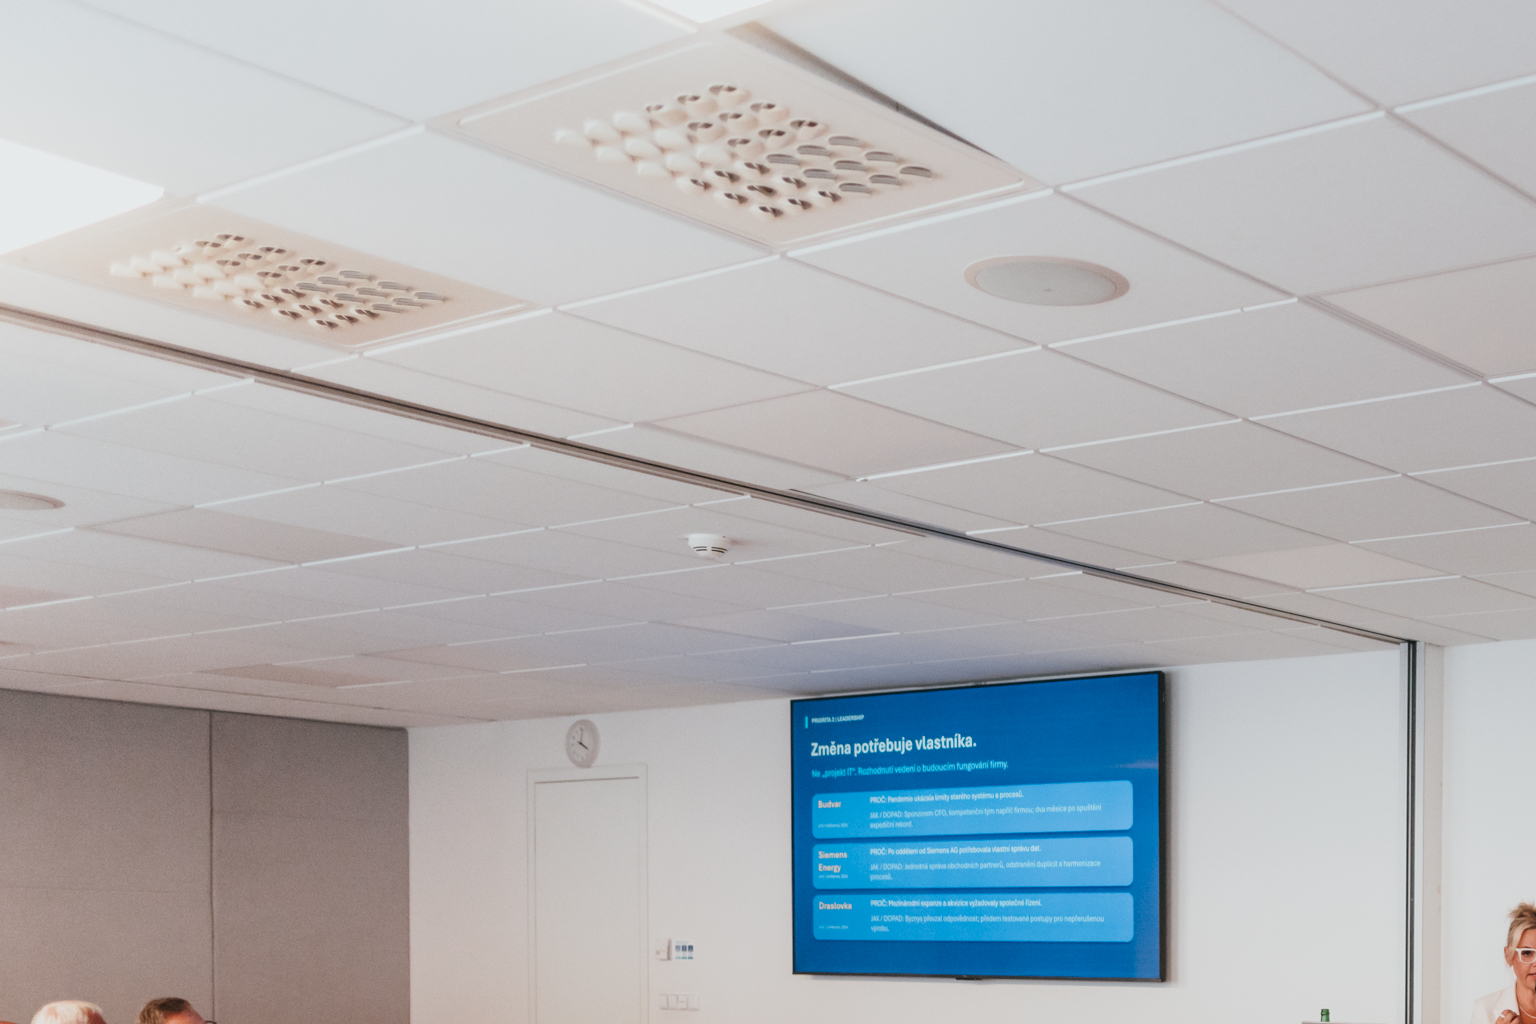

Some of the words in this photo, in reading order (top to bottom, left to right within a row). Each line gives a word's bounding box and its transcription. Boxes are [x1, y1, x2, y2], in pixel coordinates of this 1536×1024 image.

[811, 741, 851, 757] Změna
[854, 737, 913, 757] potřebuje
[915, 734, 976, 751] vlastníka.
[818, 800, 842, 809] Budvar
[819, 851, 848, 860] Siemens
[819, 864, 842, 874] Energy
[820, 902, 853, 911] Draslovka
